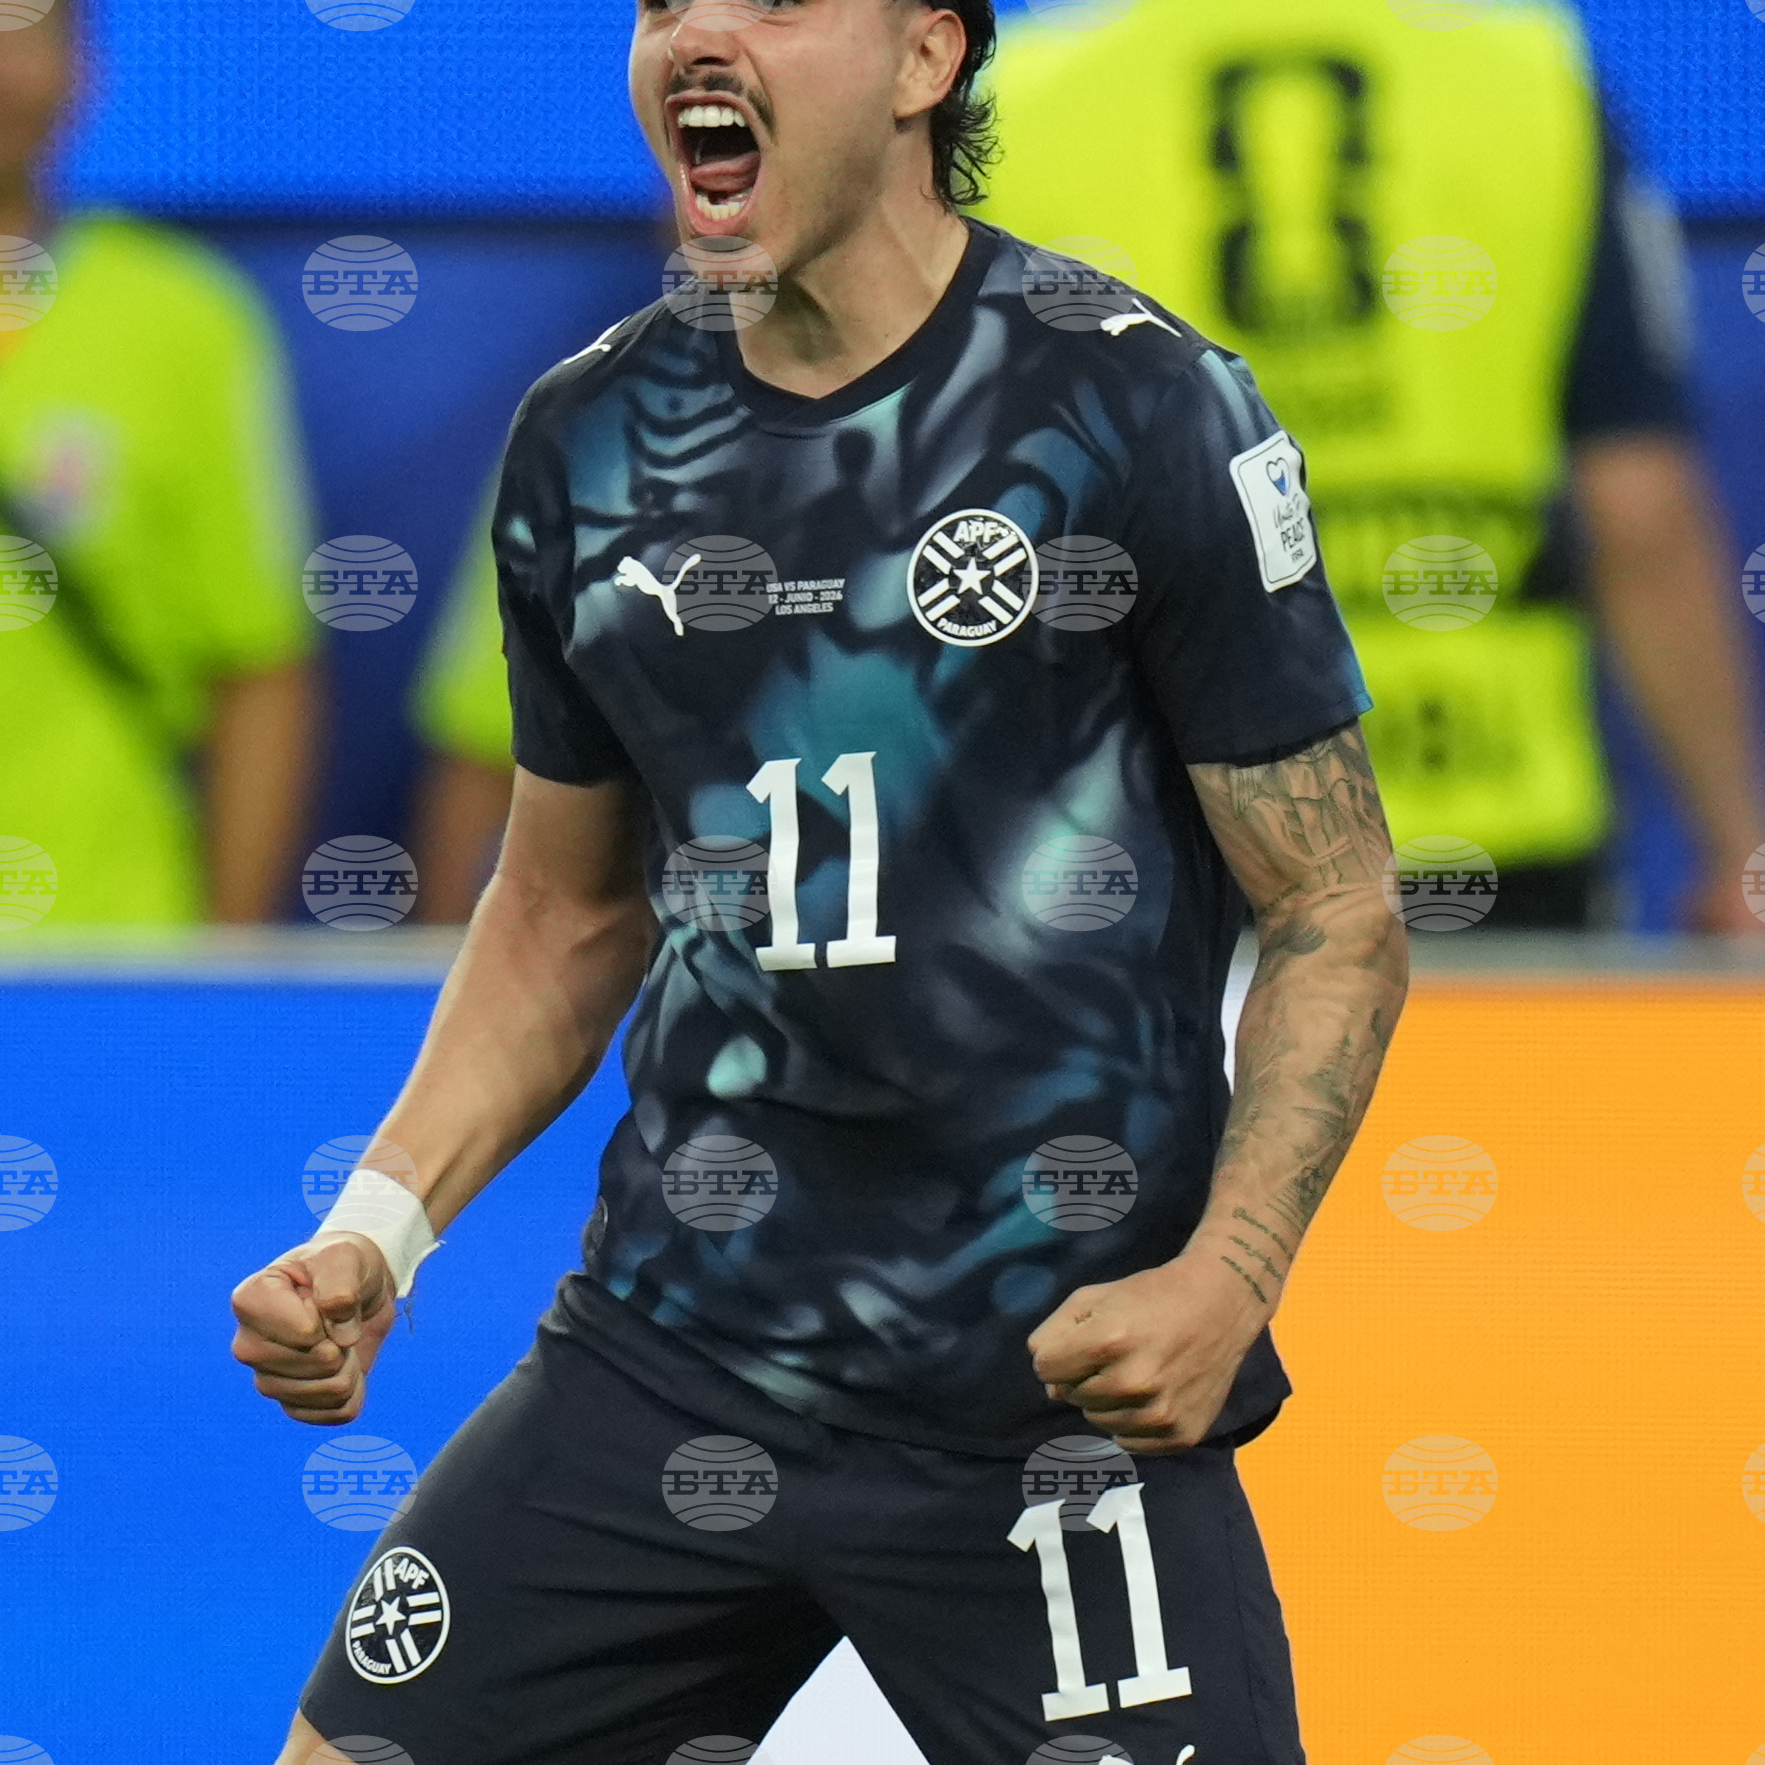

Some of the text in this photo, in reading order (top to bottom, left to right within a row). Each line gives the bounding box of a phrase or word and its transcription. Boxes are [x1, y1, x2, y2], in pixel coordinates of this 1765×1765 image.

[953, 520, 998, 542] APF
[766, 578, 846, 593] USA VS PARAGUAY
[768, 593, 779, 604] 12
[784, 592, 813, 603] JUNIO
[820, 590, 843, 601] 2026
[776, 602, 834, 615] LOS ANGELES
[936, 617, 998, 637] PARAGUAY
[745, 751, 897, 972] 11
[394, 1557, 430, 1590] APF
[1006, 1482, 1193, 1722] 11
[351, 1640, 392, 1675] PARAGUAY
